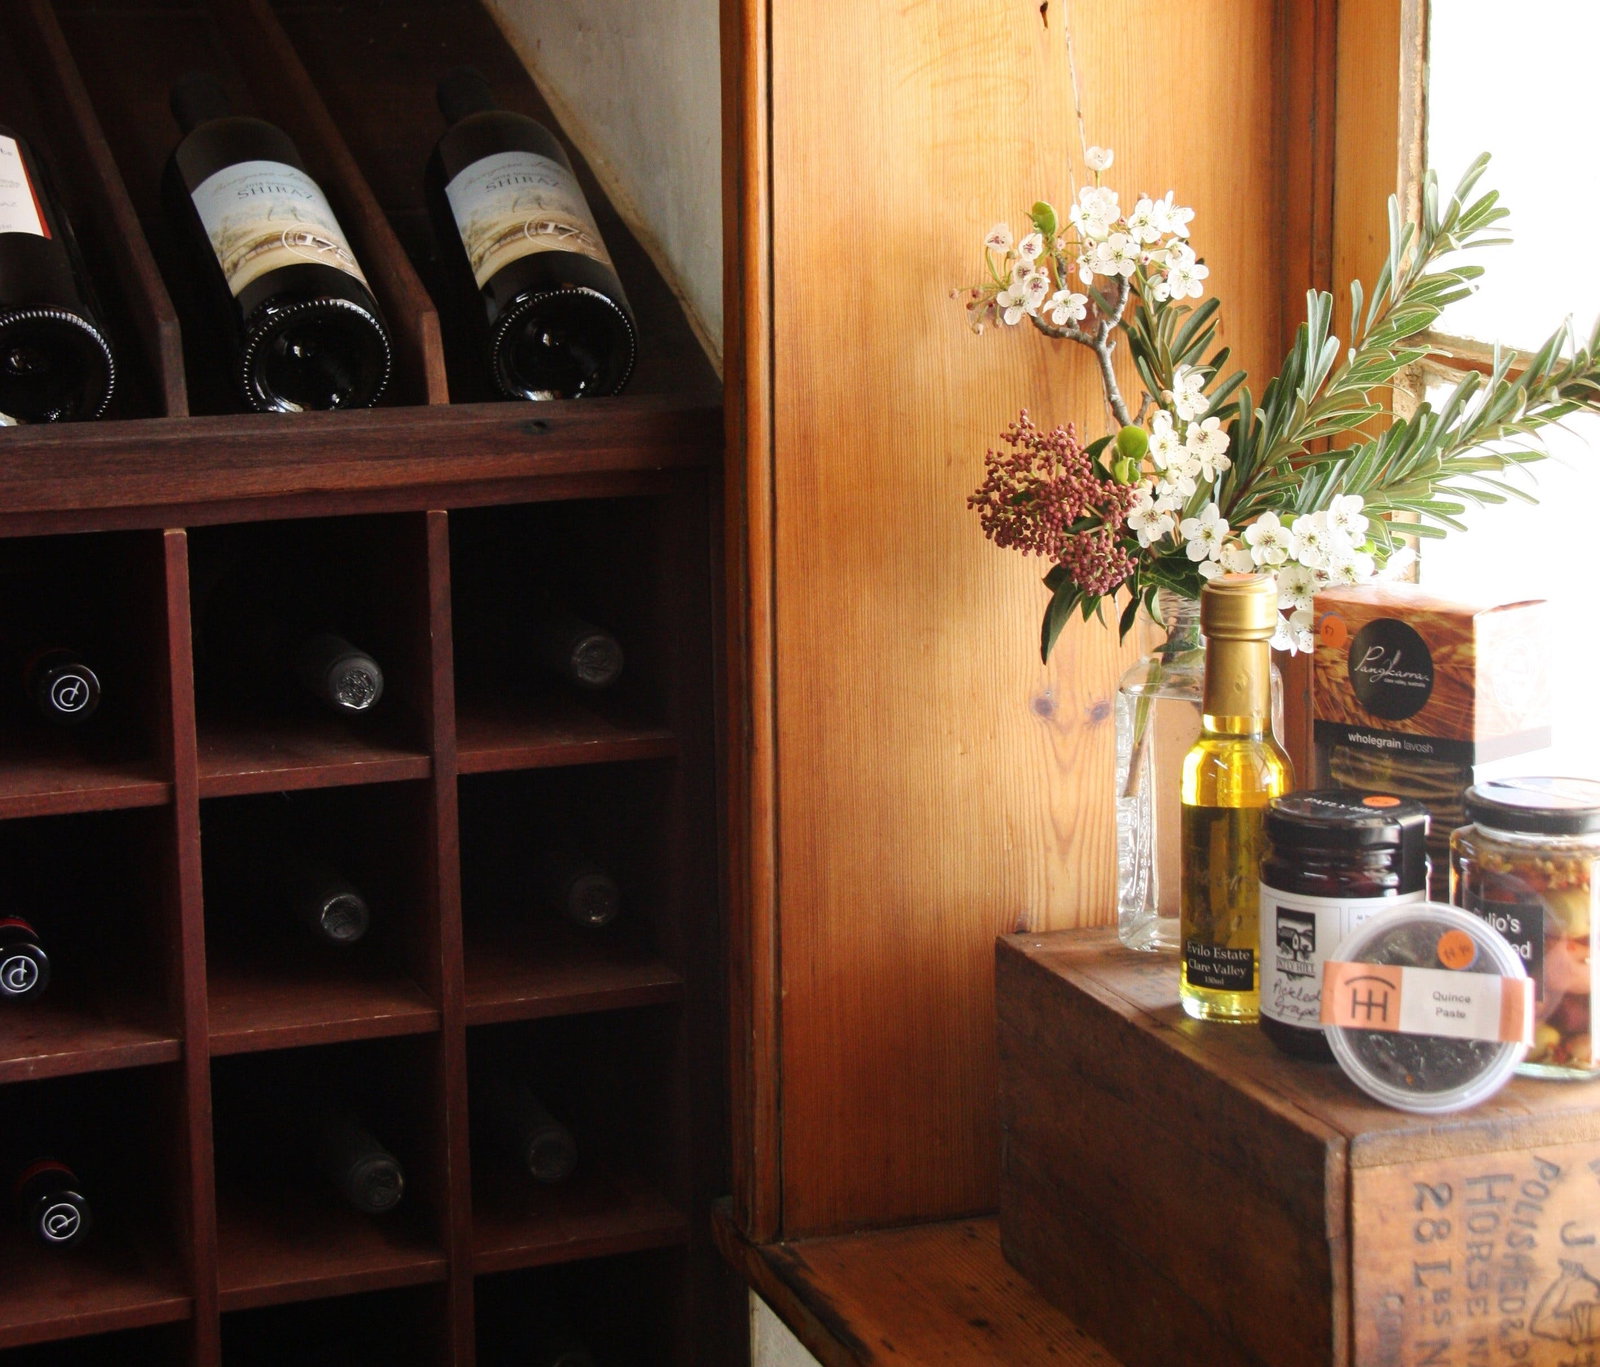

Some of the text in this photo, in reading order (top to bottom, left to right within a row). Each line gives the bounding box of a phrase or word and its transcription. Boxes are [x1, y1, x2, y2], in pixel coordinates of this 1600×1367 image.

[237, 183, 313, 200] SHIRAZ
[486, 174, 561, 192] SHIRAZ
[1348, 732, 1434, 753] wholegrain lavosh
[1187, 941, 1250, 961] Evilo Estate
[1189, 959, 1246, 978] Clare Valley
[1432, 991, 1472, 1004] Quince
[1435, 1007, 1467, 1019] Paste
[1413, 1181, 1453, 1244] 28
[1499, 1155, 1562, 1314] POLISHED
[1465, 1173, 1515, 1317] HORSE
